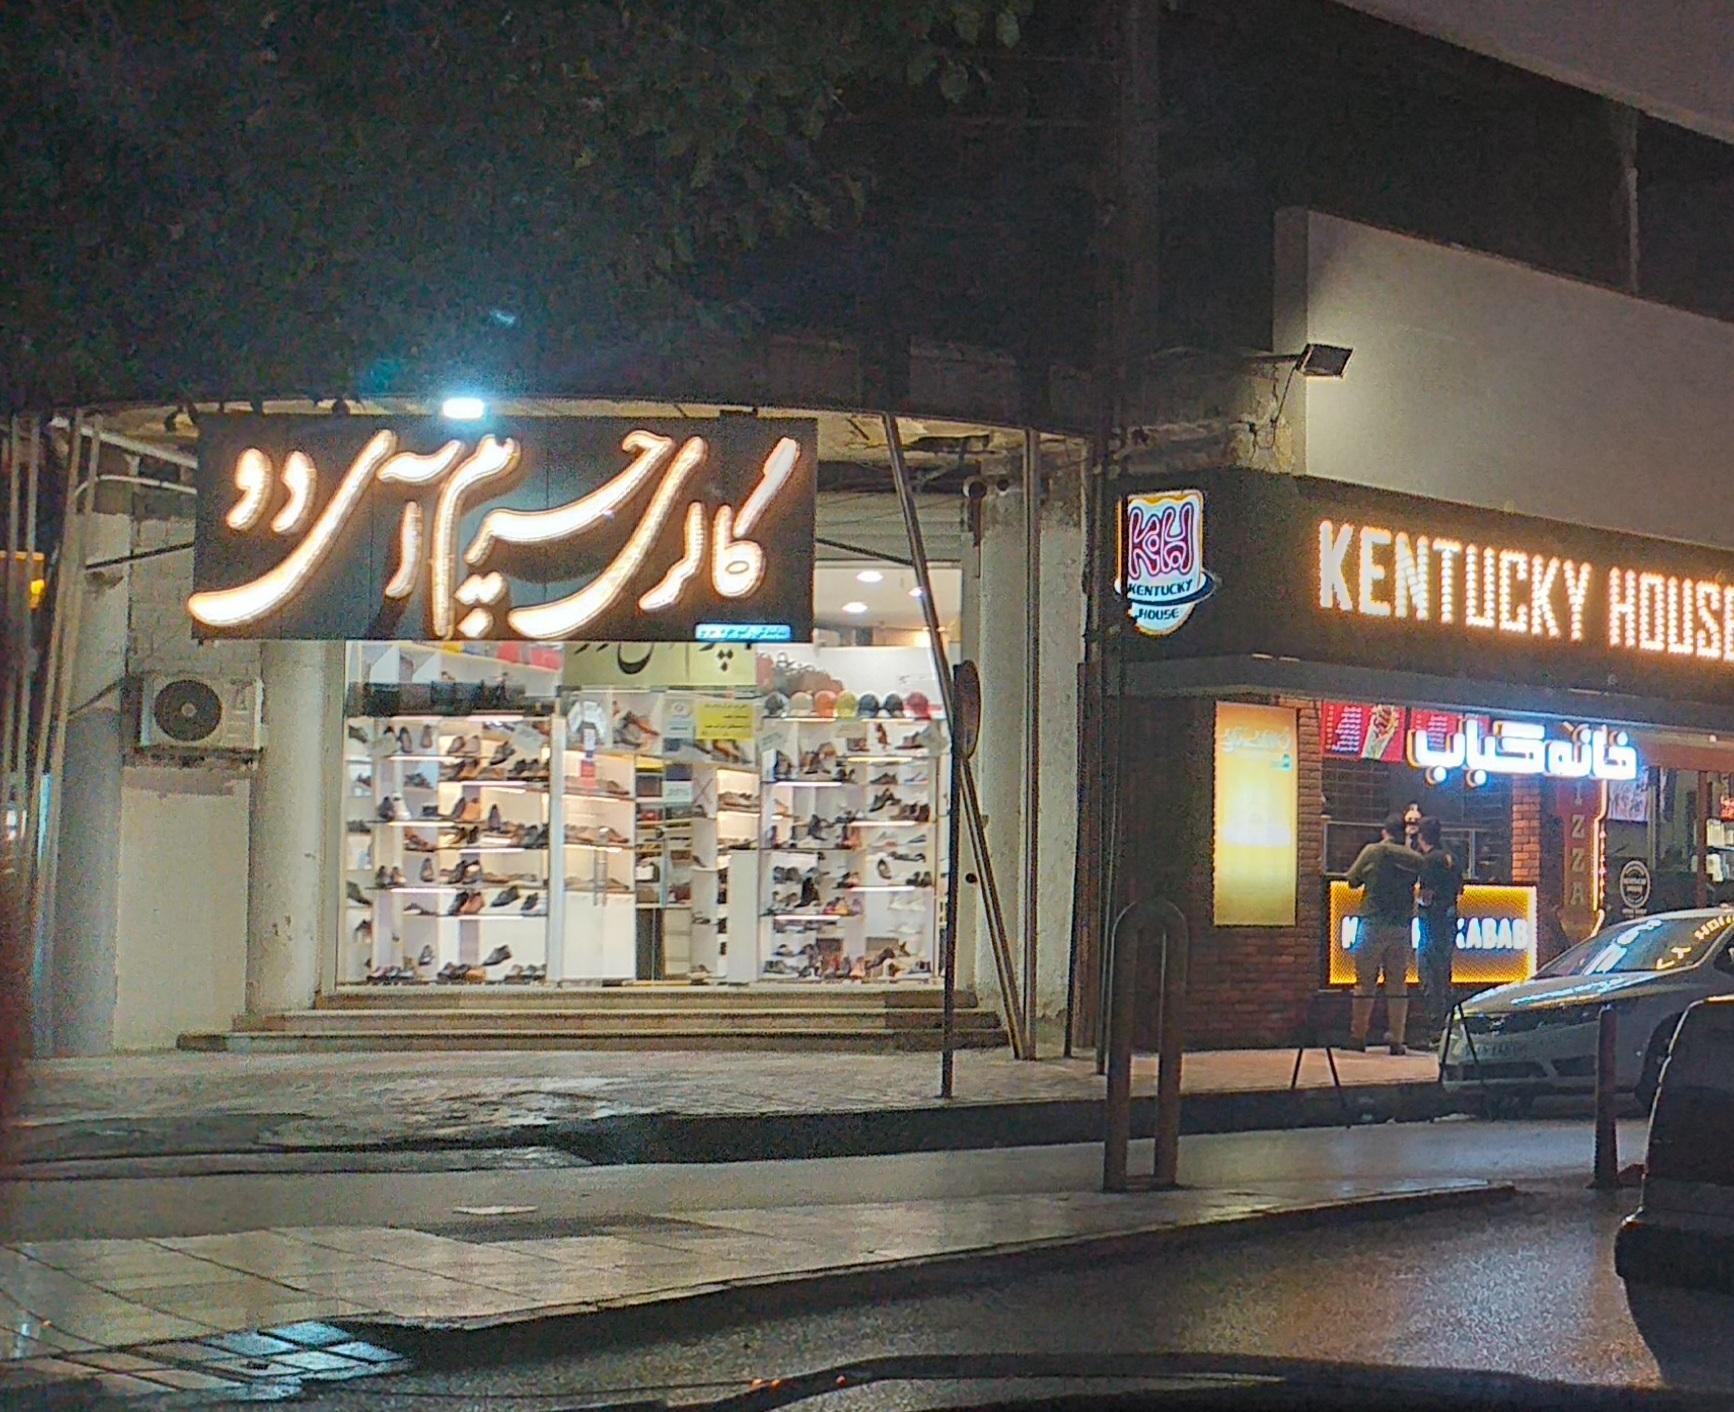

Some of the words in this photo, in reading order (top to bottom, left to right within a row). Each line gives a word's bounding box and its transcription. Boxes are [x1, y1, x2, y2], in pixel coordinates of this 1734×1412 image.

[1128, 579, 1193, 596] KENTUCKY
[1317, 518, 1593, 641] KENTUCKY
[1136, 607, 1180, 620] HOUSE
[1410, 719, 1546, 788] کباب
[1544, 723, 1638, 780] خانه
[1570, 781, 1586, 906] IZZA
